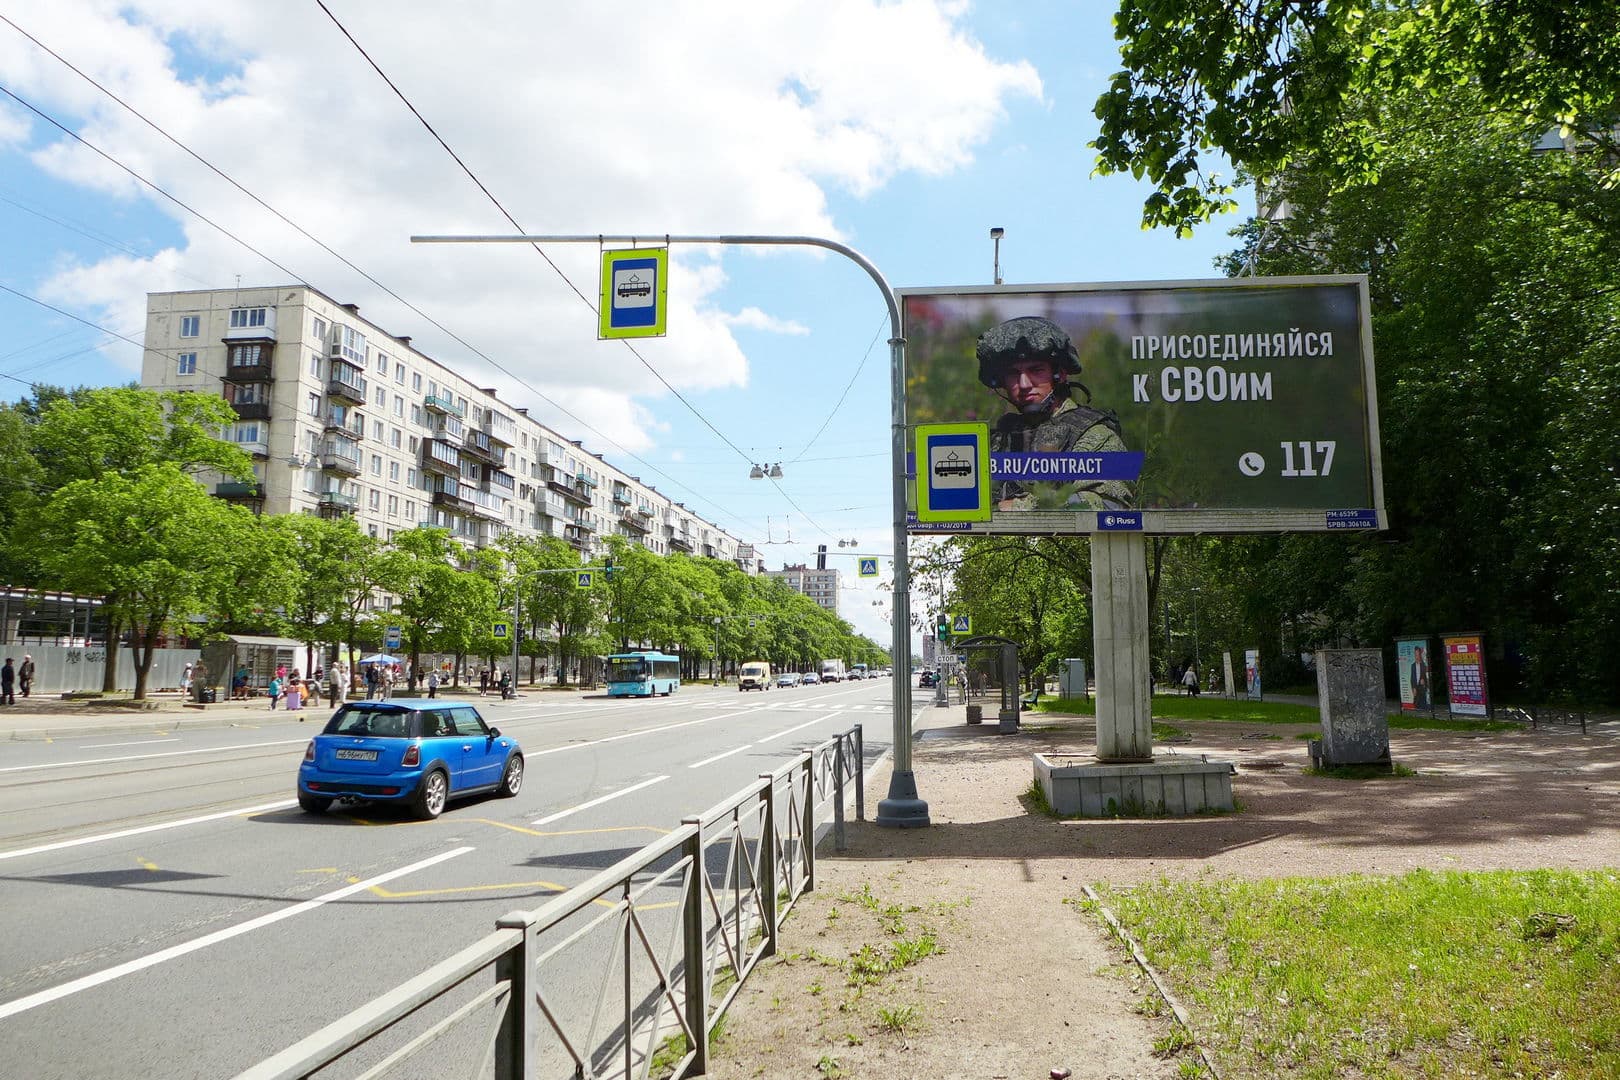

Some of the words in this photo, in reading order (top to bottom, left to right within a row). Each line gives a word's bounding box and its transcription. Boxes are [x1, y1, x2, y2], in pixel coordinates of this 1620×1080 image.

[1131, 328, 1333, 361] ПРИСОЕДИНЯЙСЯ
[1280, 440, 1337, 477] 117
[1116, 517, 1136, 525] Russ
